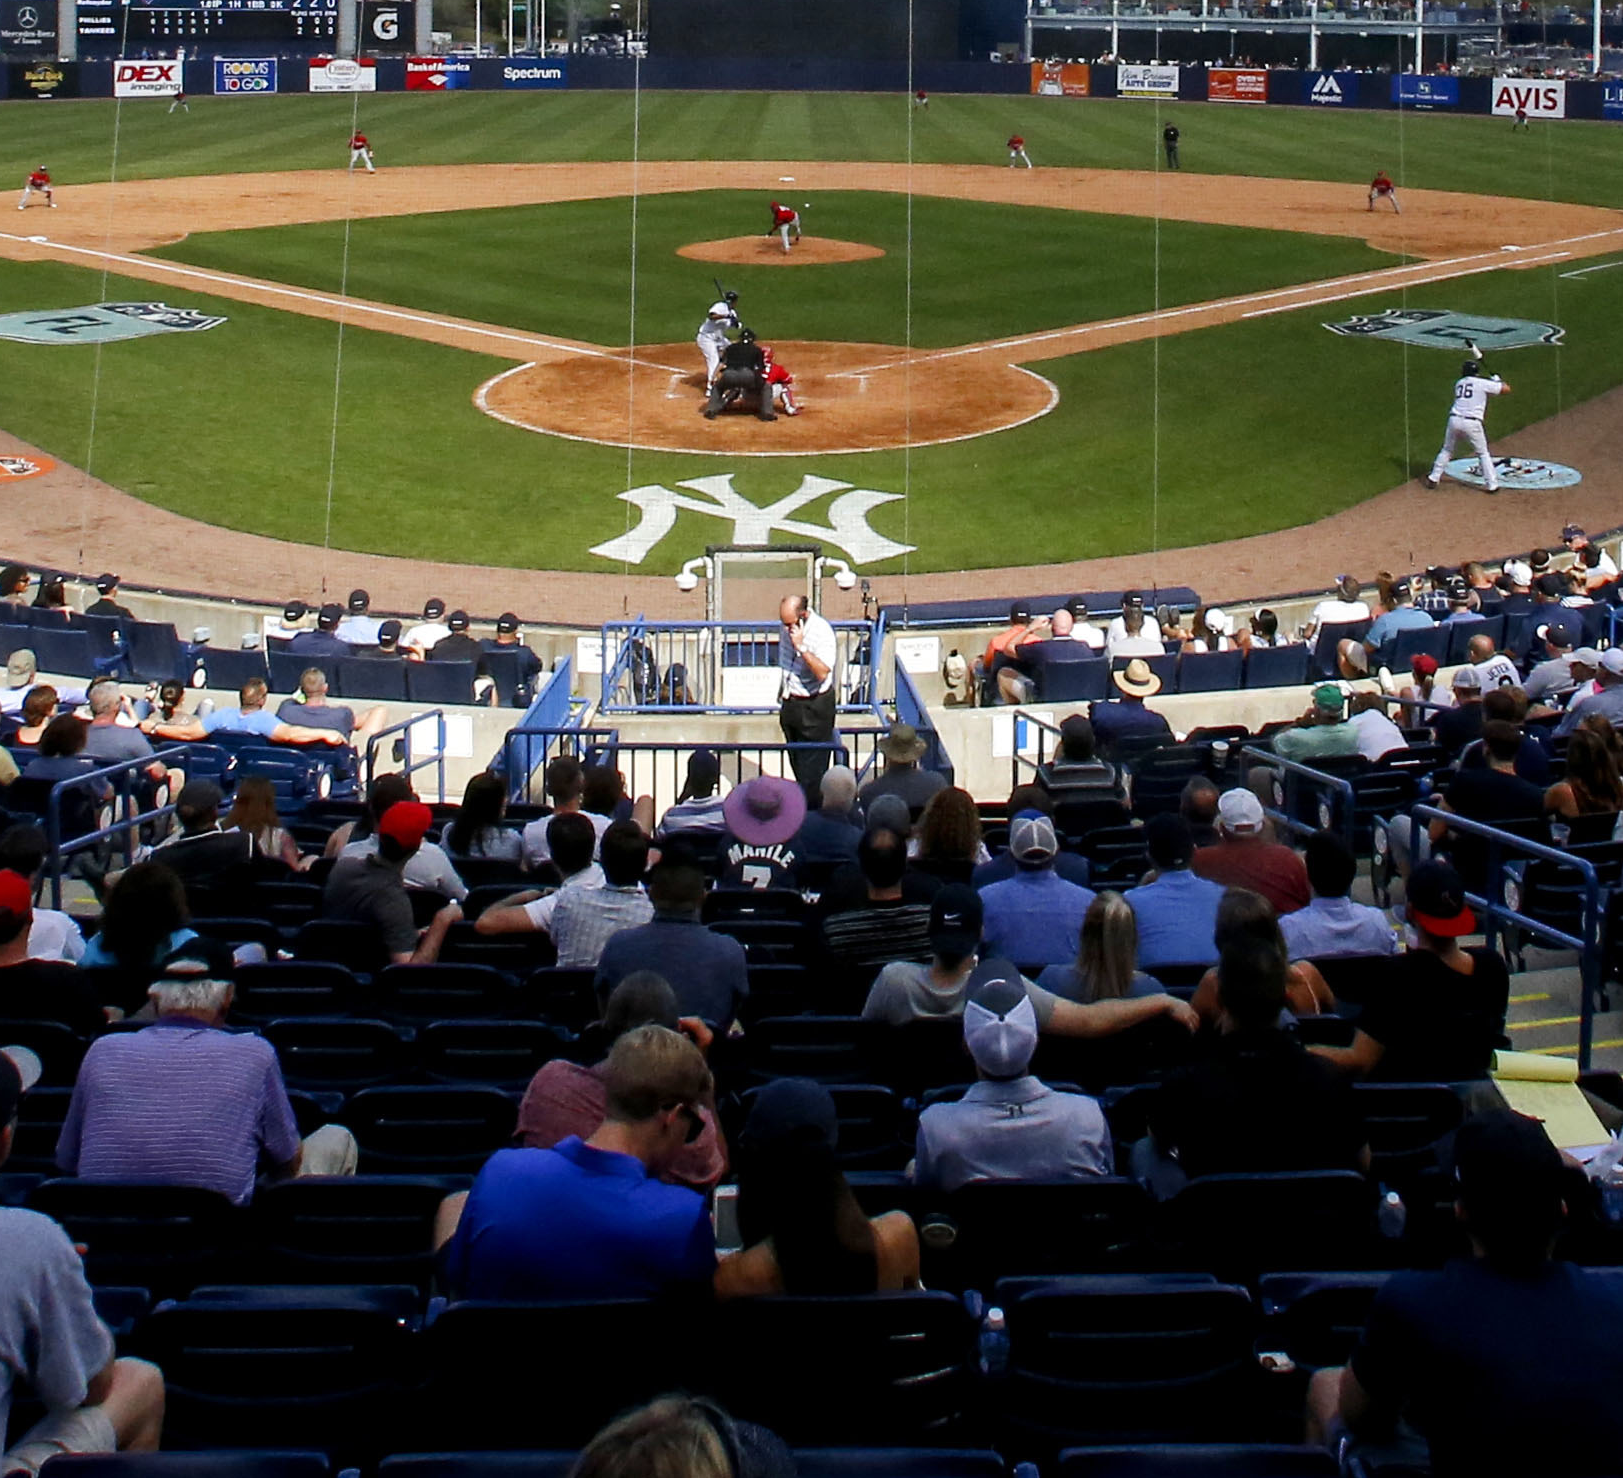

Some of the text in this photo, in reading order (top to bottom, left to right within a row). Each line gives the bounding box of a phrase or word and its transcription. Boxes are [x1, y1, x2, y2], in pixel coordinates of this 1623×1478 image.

[373, 13, 398, 40] G
[116, 65, 177, 82] DEX
[223, 63, 269, 75] ROOMS
[407, 63, 425, 71] Bank
[436, 63, 470, 72] America
[504, 68, 561, 81] Spectrum
[130, 82, 180, 91] imaging
[223, 78, 262, 90] TO GO
[1311, 94, 1343, 103] Majestic
[1495, 86, 1558, 111] AVIS
[1486, 662, 1510, 681] JETER
